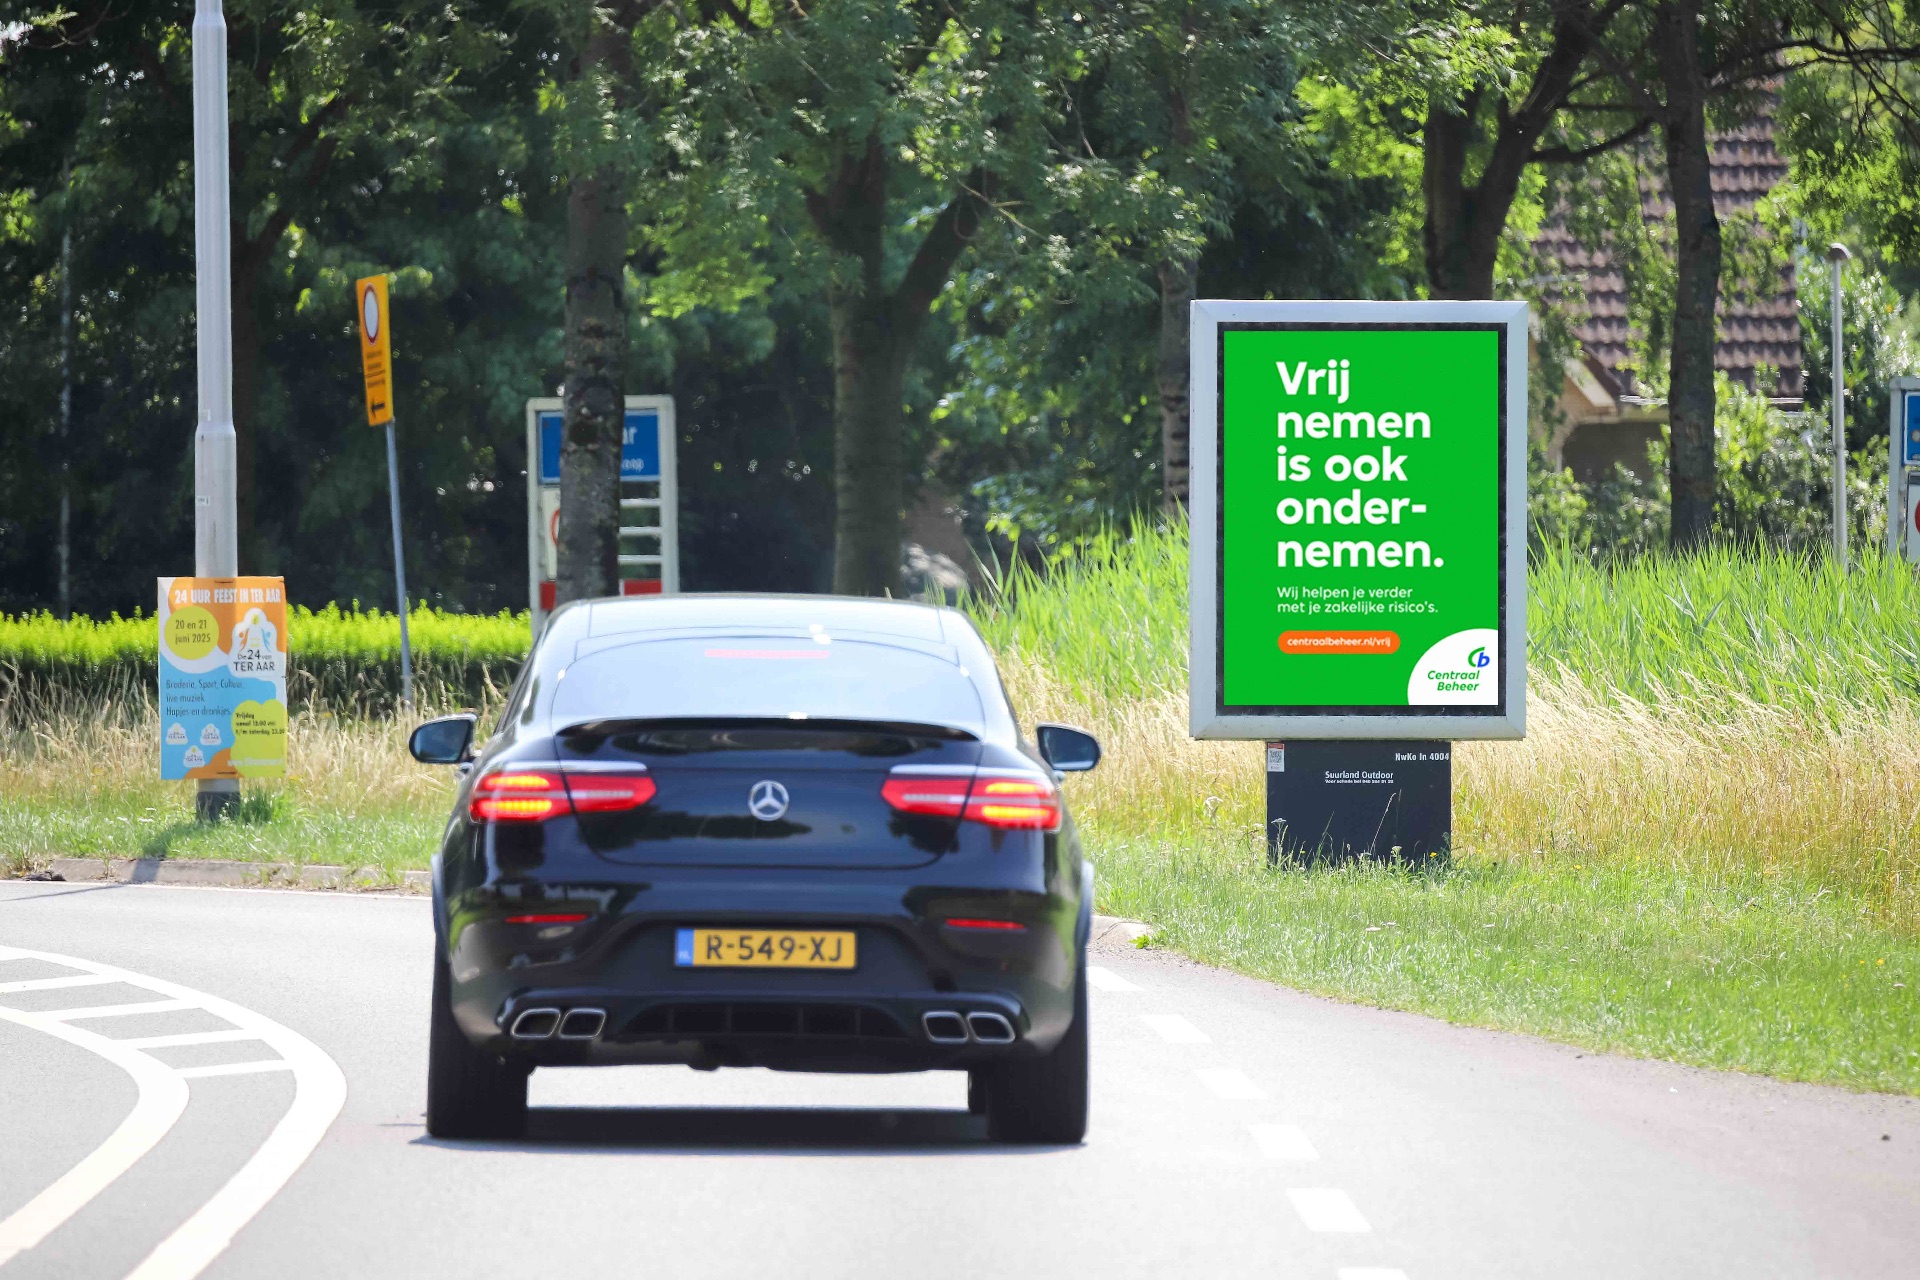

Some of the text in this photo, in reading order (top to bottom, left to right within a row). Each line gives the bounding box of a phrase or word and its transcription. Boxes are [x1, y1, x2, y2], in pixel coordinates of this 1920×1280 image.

[1275, 359, 1350, 404] Vrij
[1277, 411, 1431, 439] nemen
[1277, 445, 1409, 482] is ook
[1276, 488, 1427, 525] onder-
[1277, 540, 1444, 568] nemen.
[174, 588, 281, 604] 24 UUR FEEST IN TER AAR
[1277, 586, 1413, 600] Wij helpen je verder
[1277, 601, 1439, 615] met je zakelijke risico's.
[175, 619, 207, 630] 20 en 21
[175, 633, 211, 645] juni 2025
[1287, 636, 1391, 648] centraalbeheer.nl/vrij
[247, 649, 261, 660] 24
[233, 661, 276, 672] TER AAR
[1427, 669, 1480, 680] Centraal
[1437, 681, 1480, 691] Beheer
[166, 707, 189, 718] Hapjes
[191, 708, 200, 716] en
[1429, 752, 1450, 761] 4004
[1325, 770, 1394, 779] Suurland Outdoor
[706, 934, 842, 962] R-549-XJ
